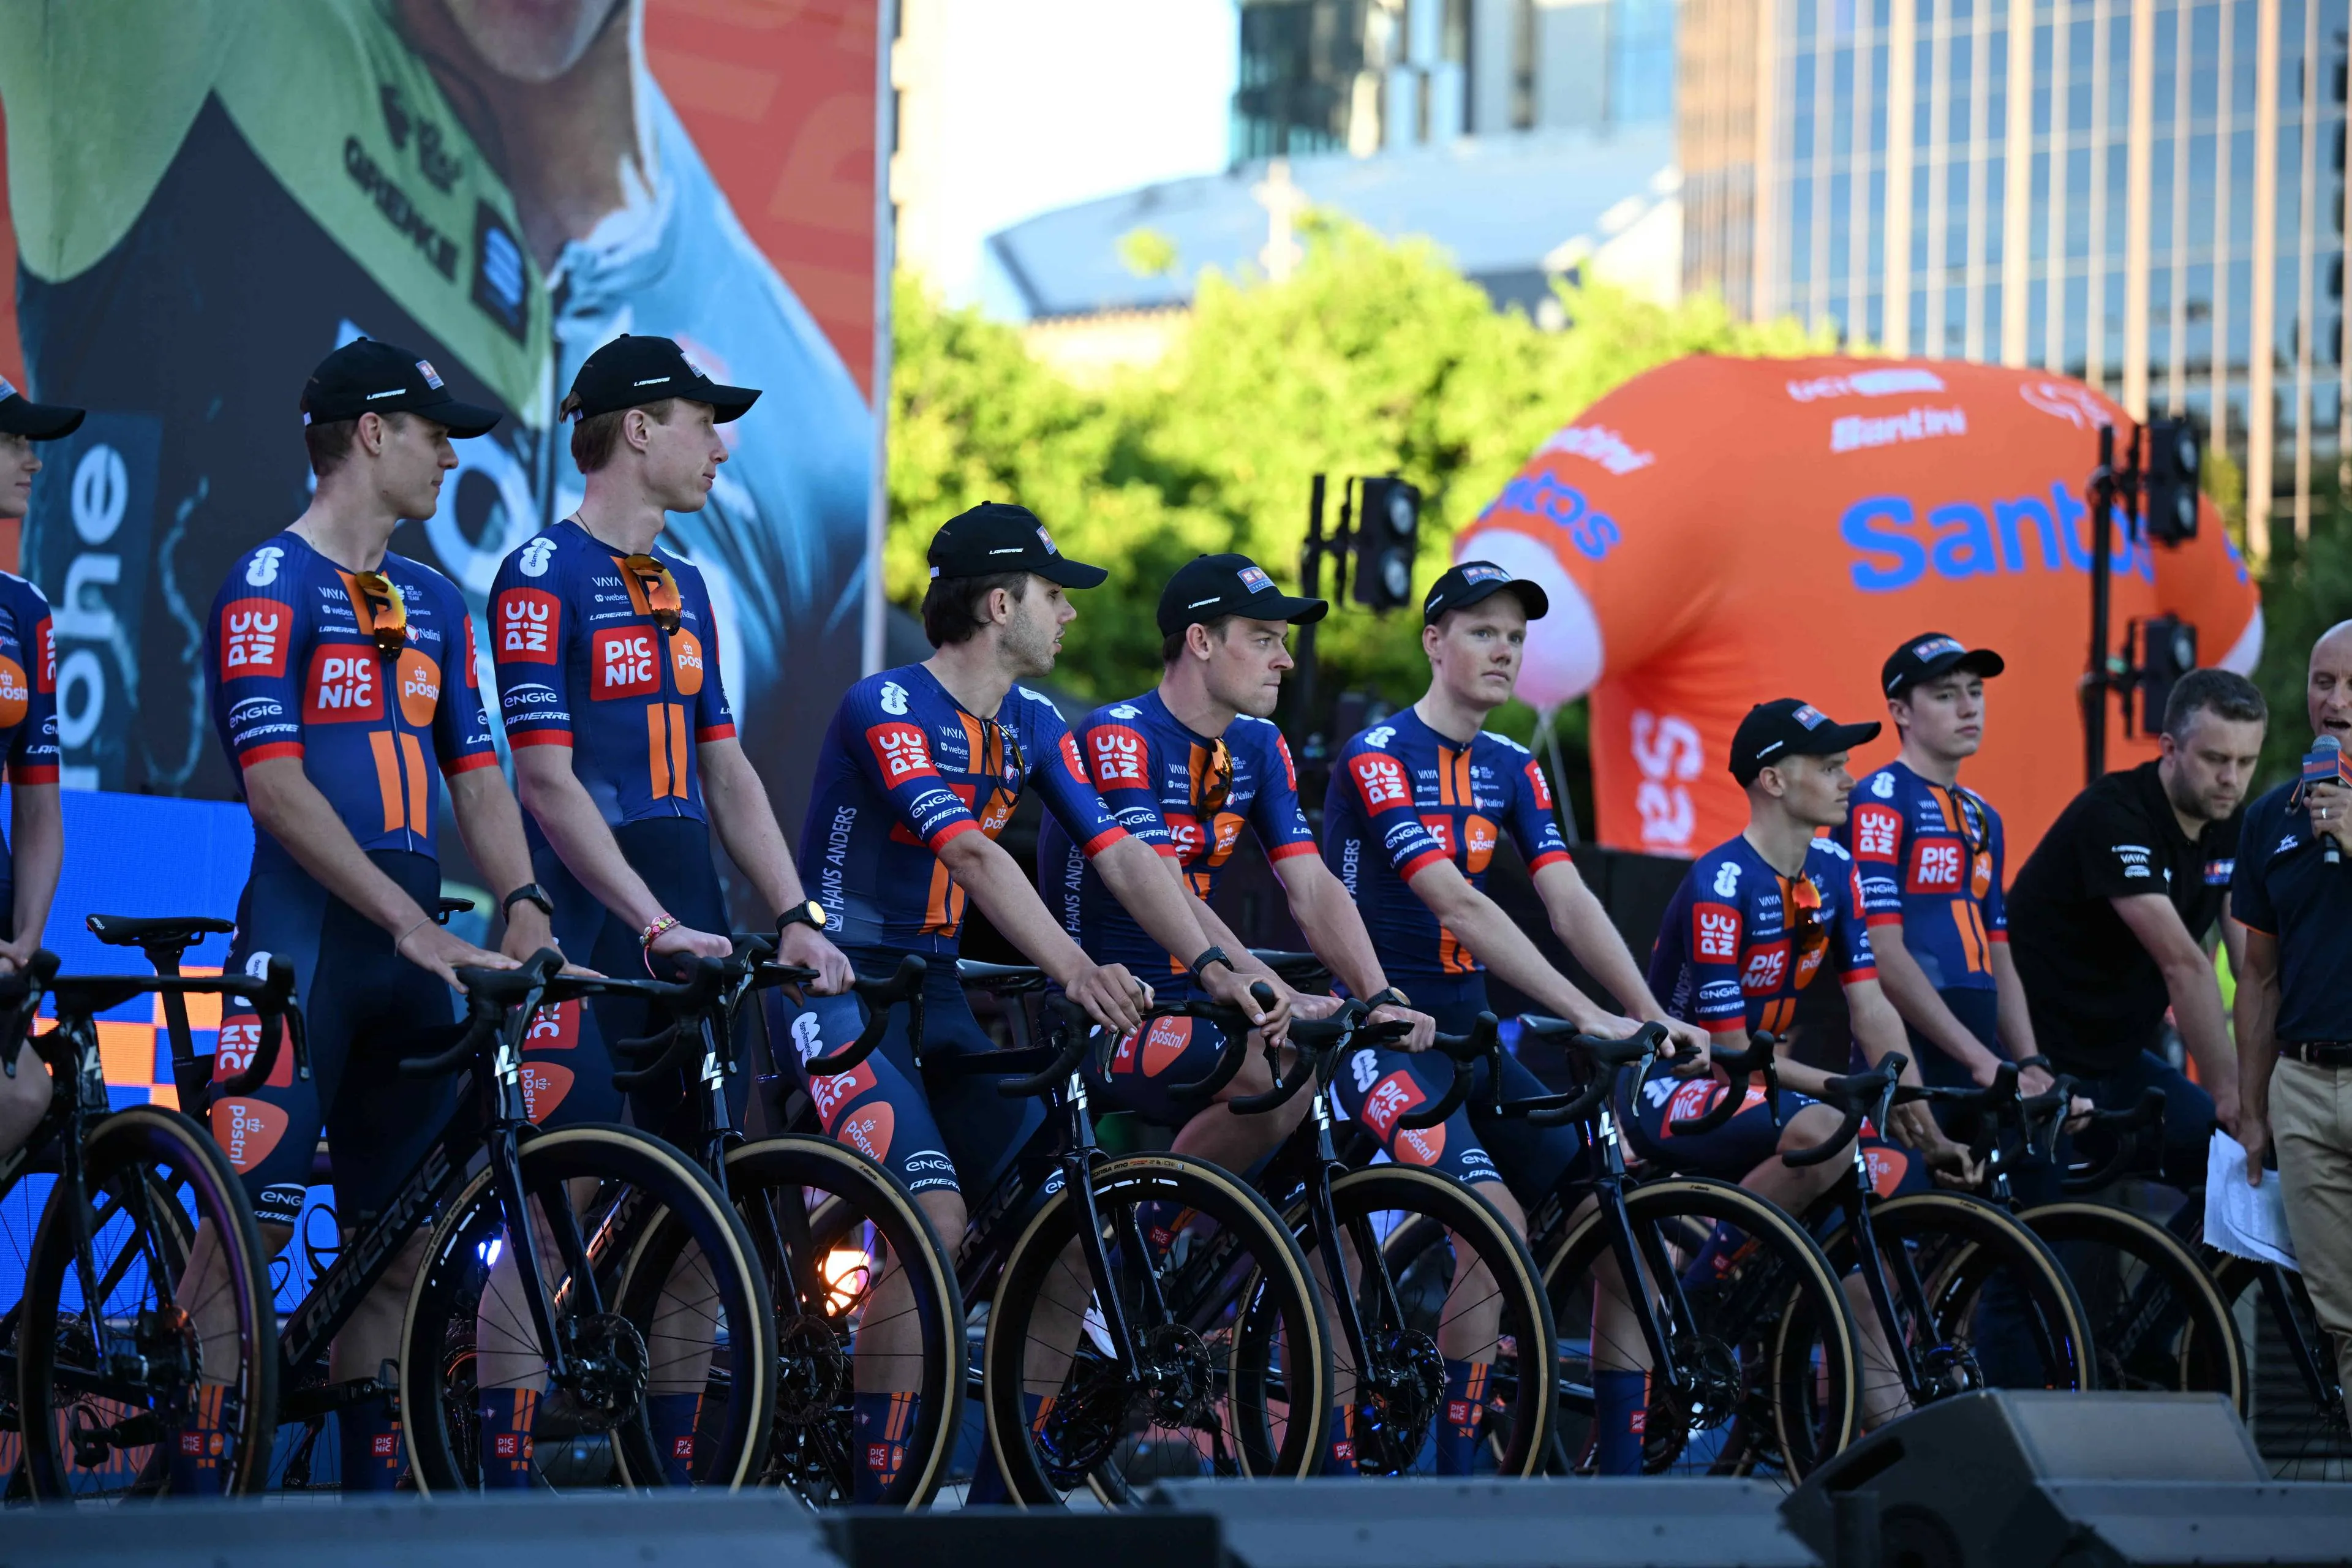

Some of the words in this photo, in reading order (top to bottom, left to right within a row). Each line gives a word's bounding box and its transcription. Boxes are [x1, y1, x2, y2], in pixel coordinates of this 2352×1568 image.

[318, 586, 349, 601] VAYA
[592, 576, 623, 587] VAYA
[505, 600, 526, 651] PIC
[589, 611, 633, 621] LAPIERRE
[228, 611, 252, 668] PIC
[318, 625, 358, 635] LAPIERRE
[419, 628, 441, 642] Nalini
[605, 637, 652, 663] PIC
[322, 657, 372, 684] PIC
[938, 725, 967, 741] VAYA
[879, 731, 911, 776] PIC
[948, 745, 968, 756] webex
[1096, 734, 1118, 780] PIC
[1169, 763, 1189, 775] VAYA
[1417, 769, 1439, 780] VAYA
[1359, 761, 1387, 805] PIC
[826, 805, 858, 867] ANDERS
[1860, 813, 1878, 853] PIC
[1921, 846, 1959, 865] PIC
[821, 867, 845, 911] HANS
[1758, 895, 1781, 907] VAYA
[1064, 894, 1081, 932] HANS
[1701, 913, 1718, 955] PIC
[1748, 950, 1785, 971] PIC
[1149, 1029, 1187, 1050] postnl
[1376, 1080, 1409, 1112] PIC
[228, 1104, 246, 1166] postnl
